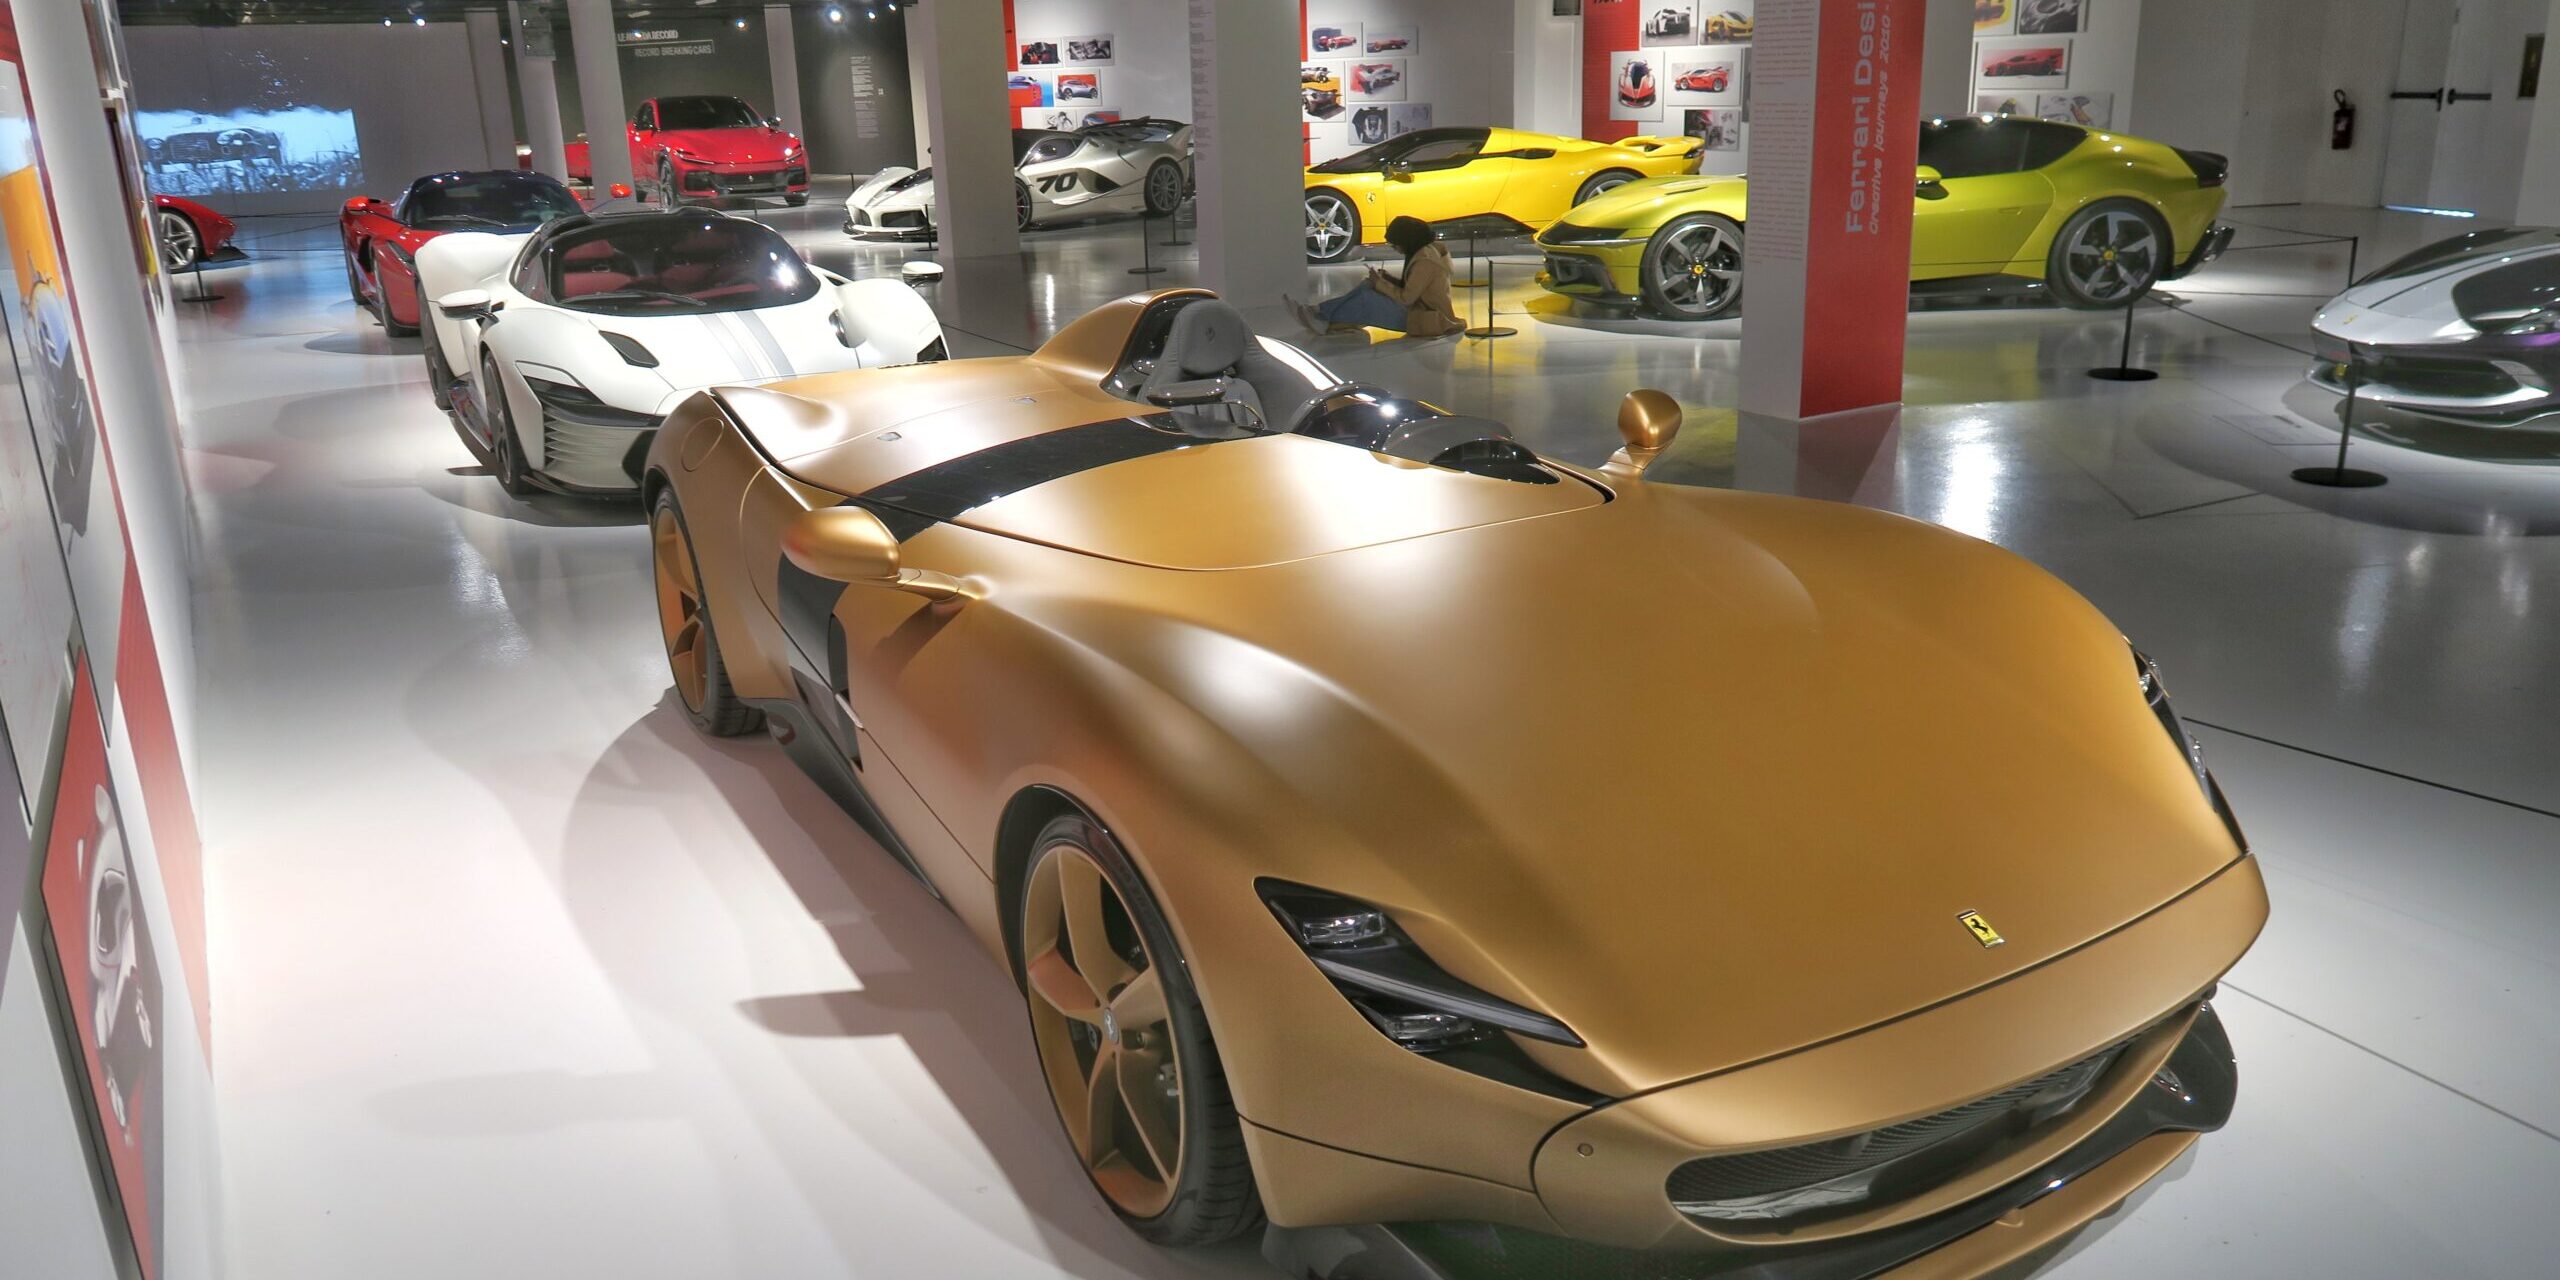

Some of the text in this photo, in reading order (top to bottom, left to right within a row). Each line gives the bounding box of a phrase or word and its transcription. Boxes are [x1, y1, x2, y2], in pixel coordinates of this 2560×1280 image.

[652, 29, 679, 40] RECORD
[1880, 14, 1891, 64] 2010
[1845, 2, 1877, 234] Ferrari Desi
[1874, 70, 1888, 152] journeys
[1036, 171, 1079, 195] 70
